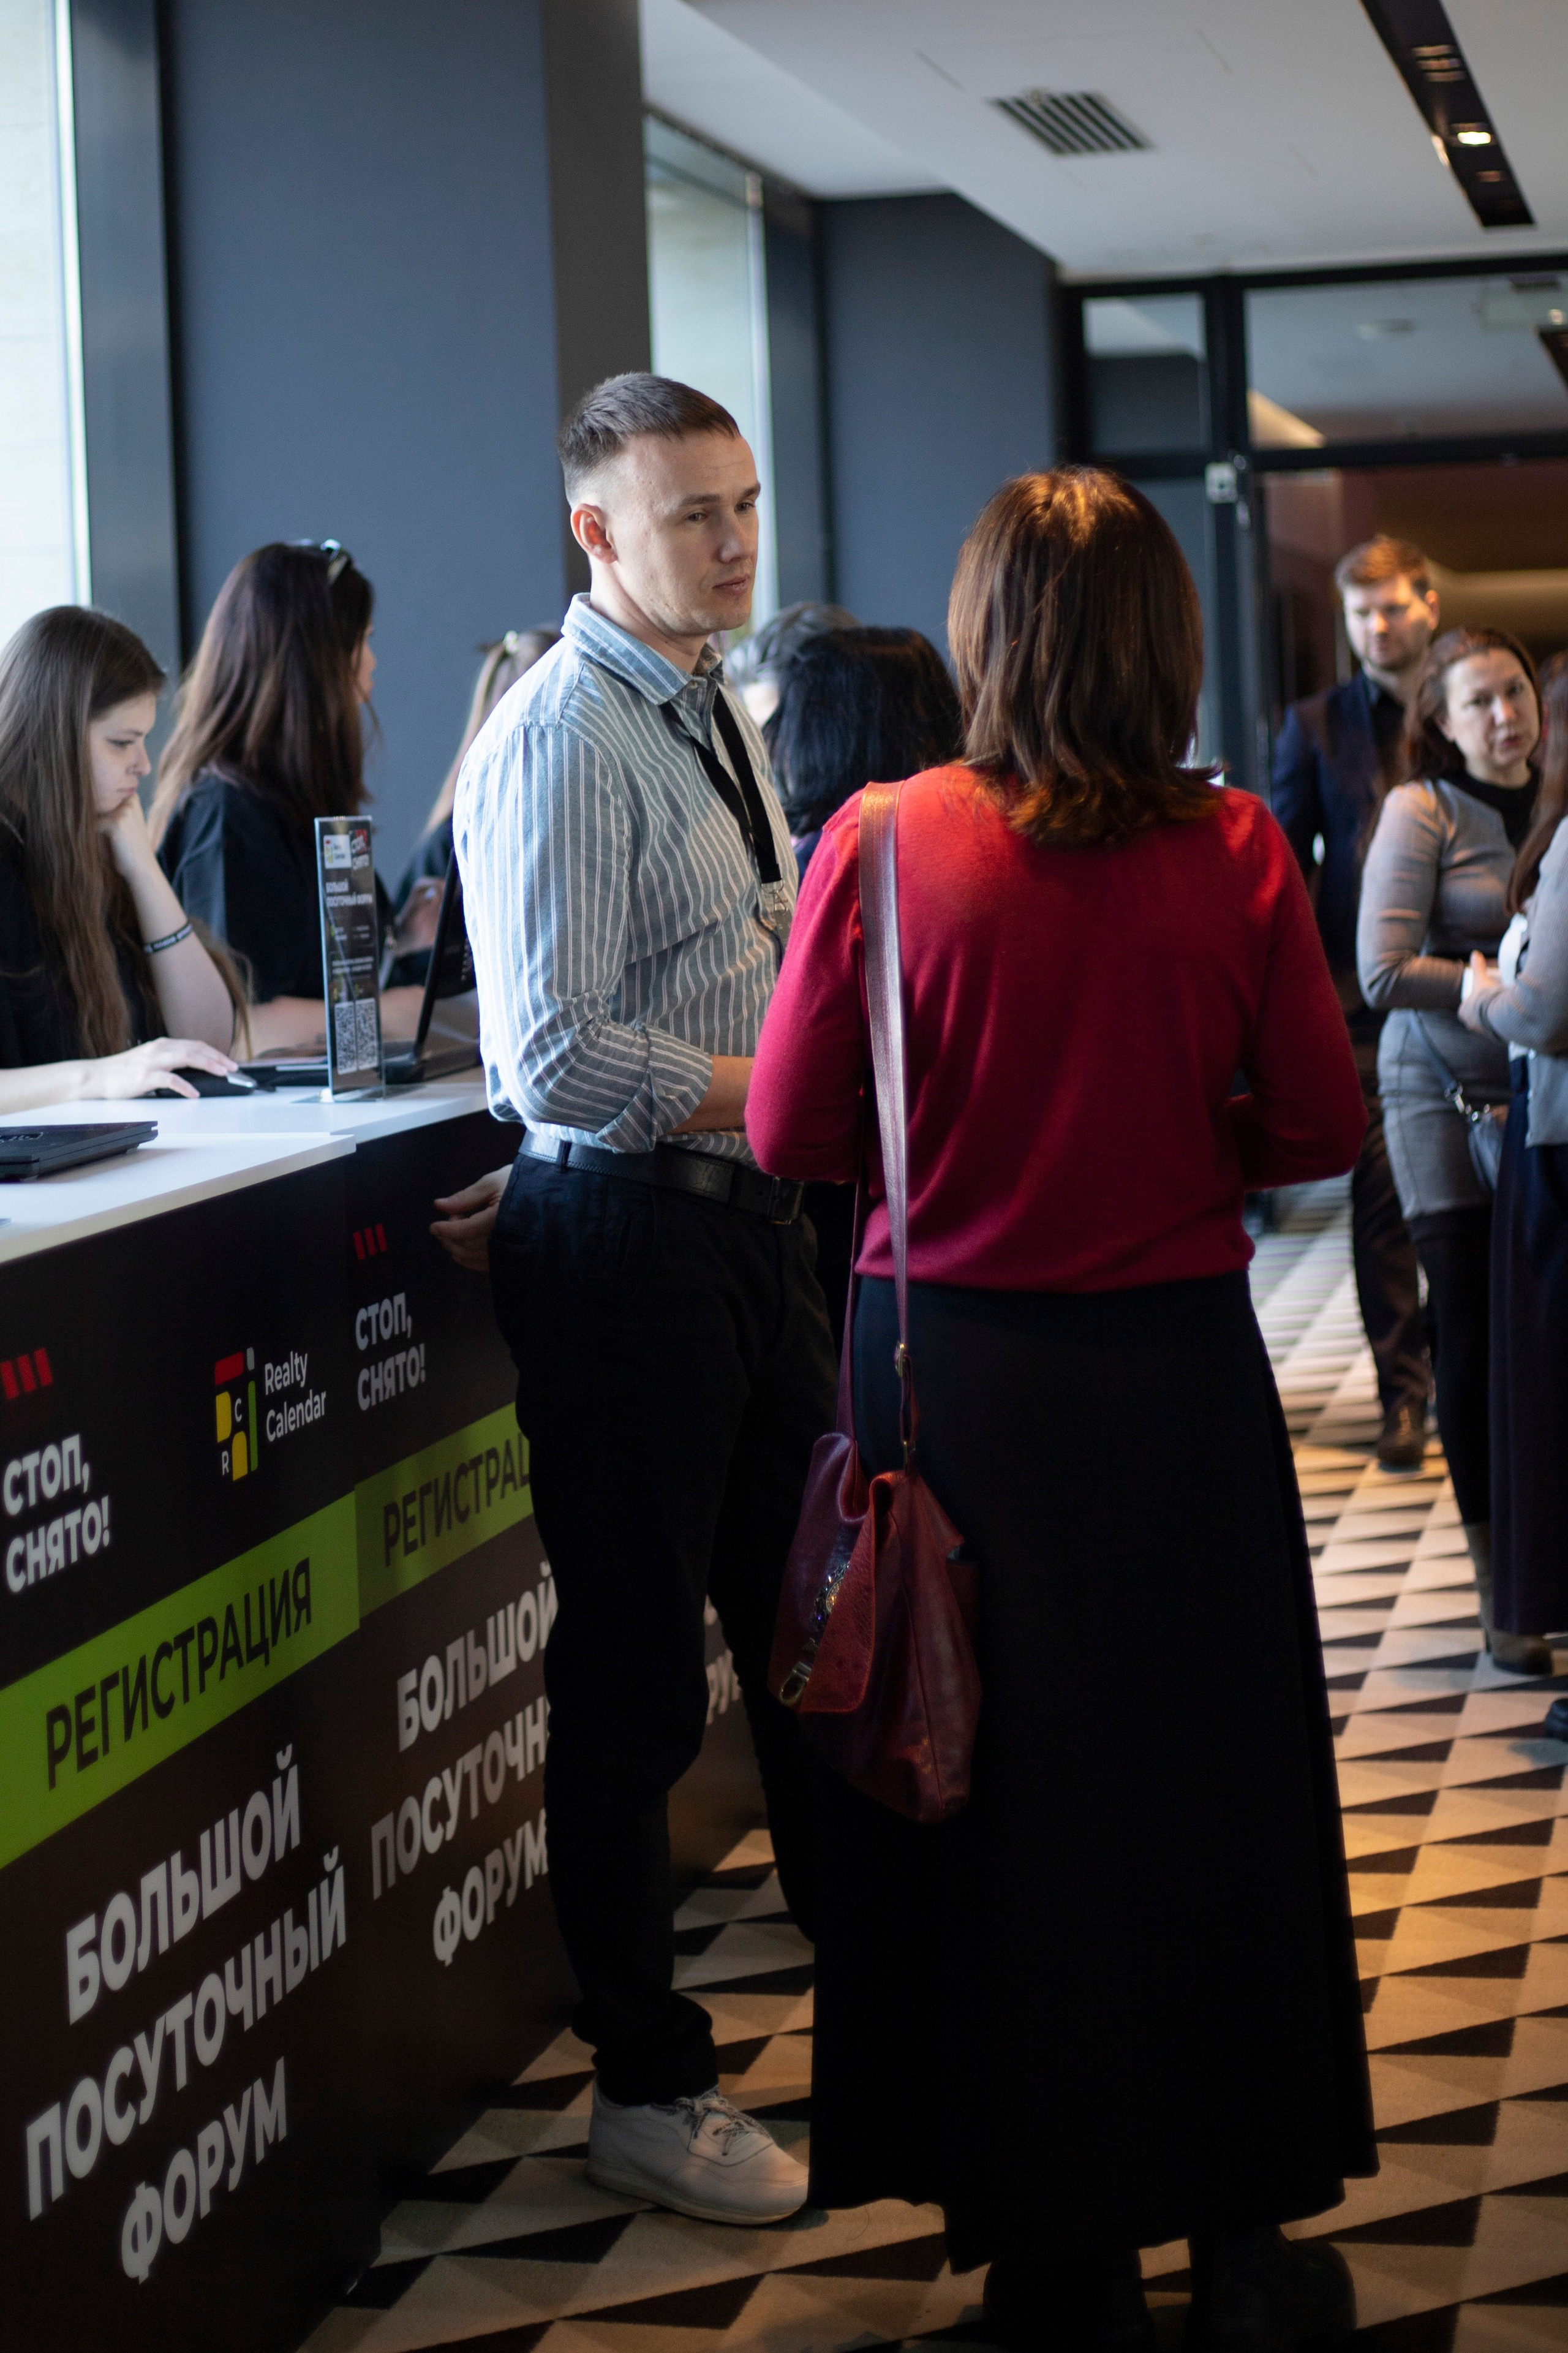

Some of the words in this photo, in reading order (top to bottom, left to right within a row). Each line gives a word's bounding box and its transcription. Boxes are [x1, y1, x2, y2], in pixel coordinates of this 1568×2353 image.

[265, 1351, 308, 1396] Realty
[355, 1291, 412, 1351] СТОП,
[357, 1342, 426, 1411] СНЯТО!
[3, 1433, 89, 1516] СТОП,
[266, 1389, 326, 1442] Calendar
[6, 1495, 110, 1593] СНЯТО!
[45, 1557, 312, 1791] РЕГИСТРАЦИЯ
[396, 1560, 559, 1753] БОЛЬШОЙ
[371, 1694, 551, 1901] ПОСУТОЧН
[66, 1743, 301, 2026] БОЛЬШОЙ
[432, 1808, 549, 1966] ФОРУМ
[26, 1845, 347, 2222] ПОСУТОЧНЫЙ
[122, 2057, 287, 2285] ФОРУМ
